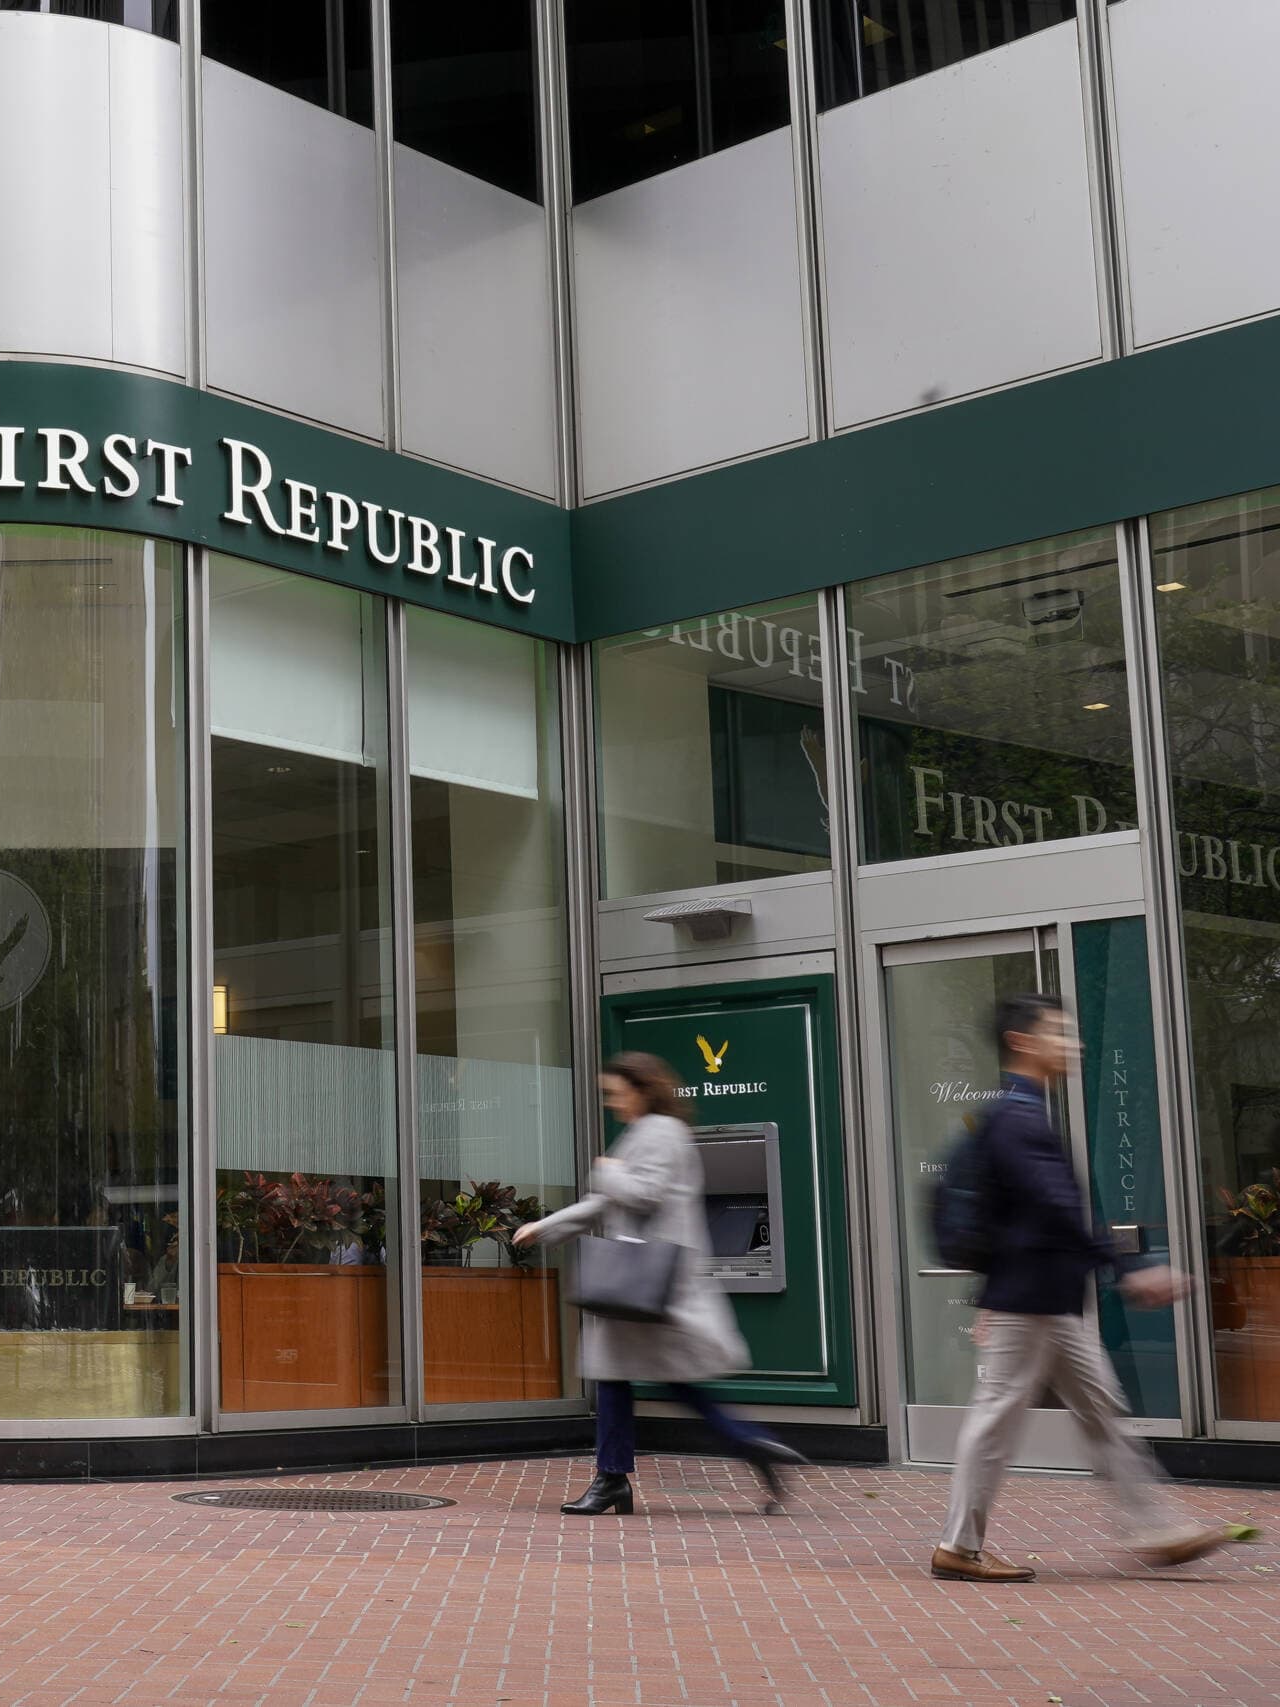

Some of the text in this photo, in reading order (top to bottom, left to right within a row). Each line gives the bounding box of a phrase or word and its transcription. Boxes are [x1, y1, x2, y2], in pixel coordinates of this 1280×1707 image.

[221, 437, 537, 604] REPUBLIC
[673, 1082, 768, 1098] IRST REPUBLIC
[929, 1080, 1006, 1103] Welcome
[1113, 1049, 1136, 1211] ENTRANCE
